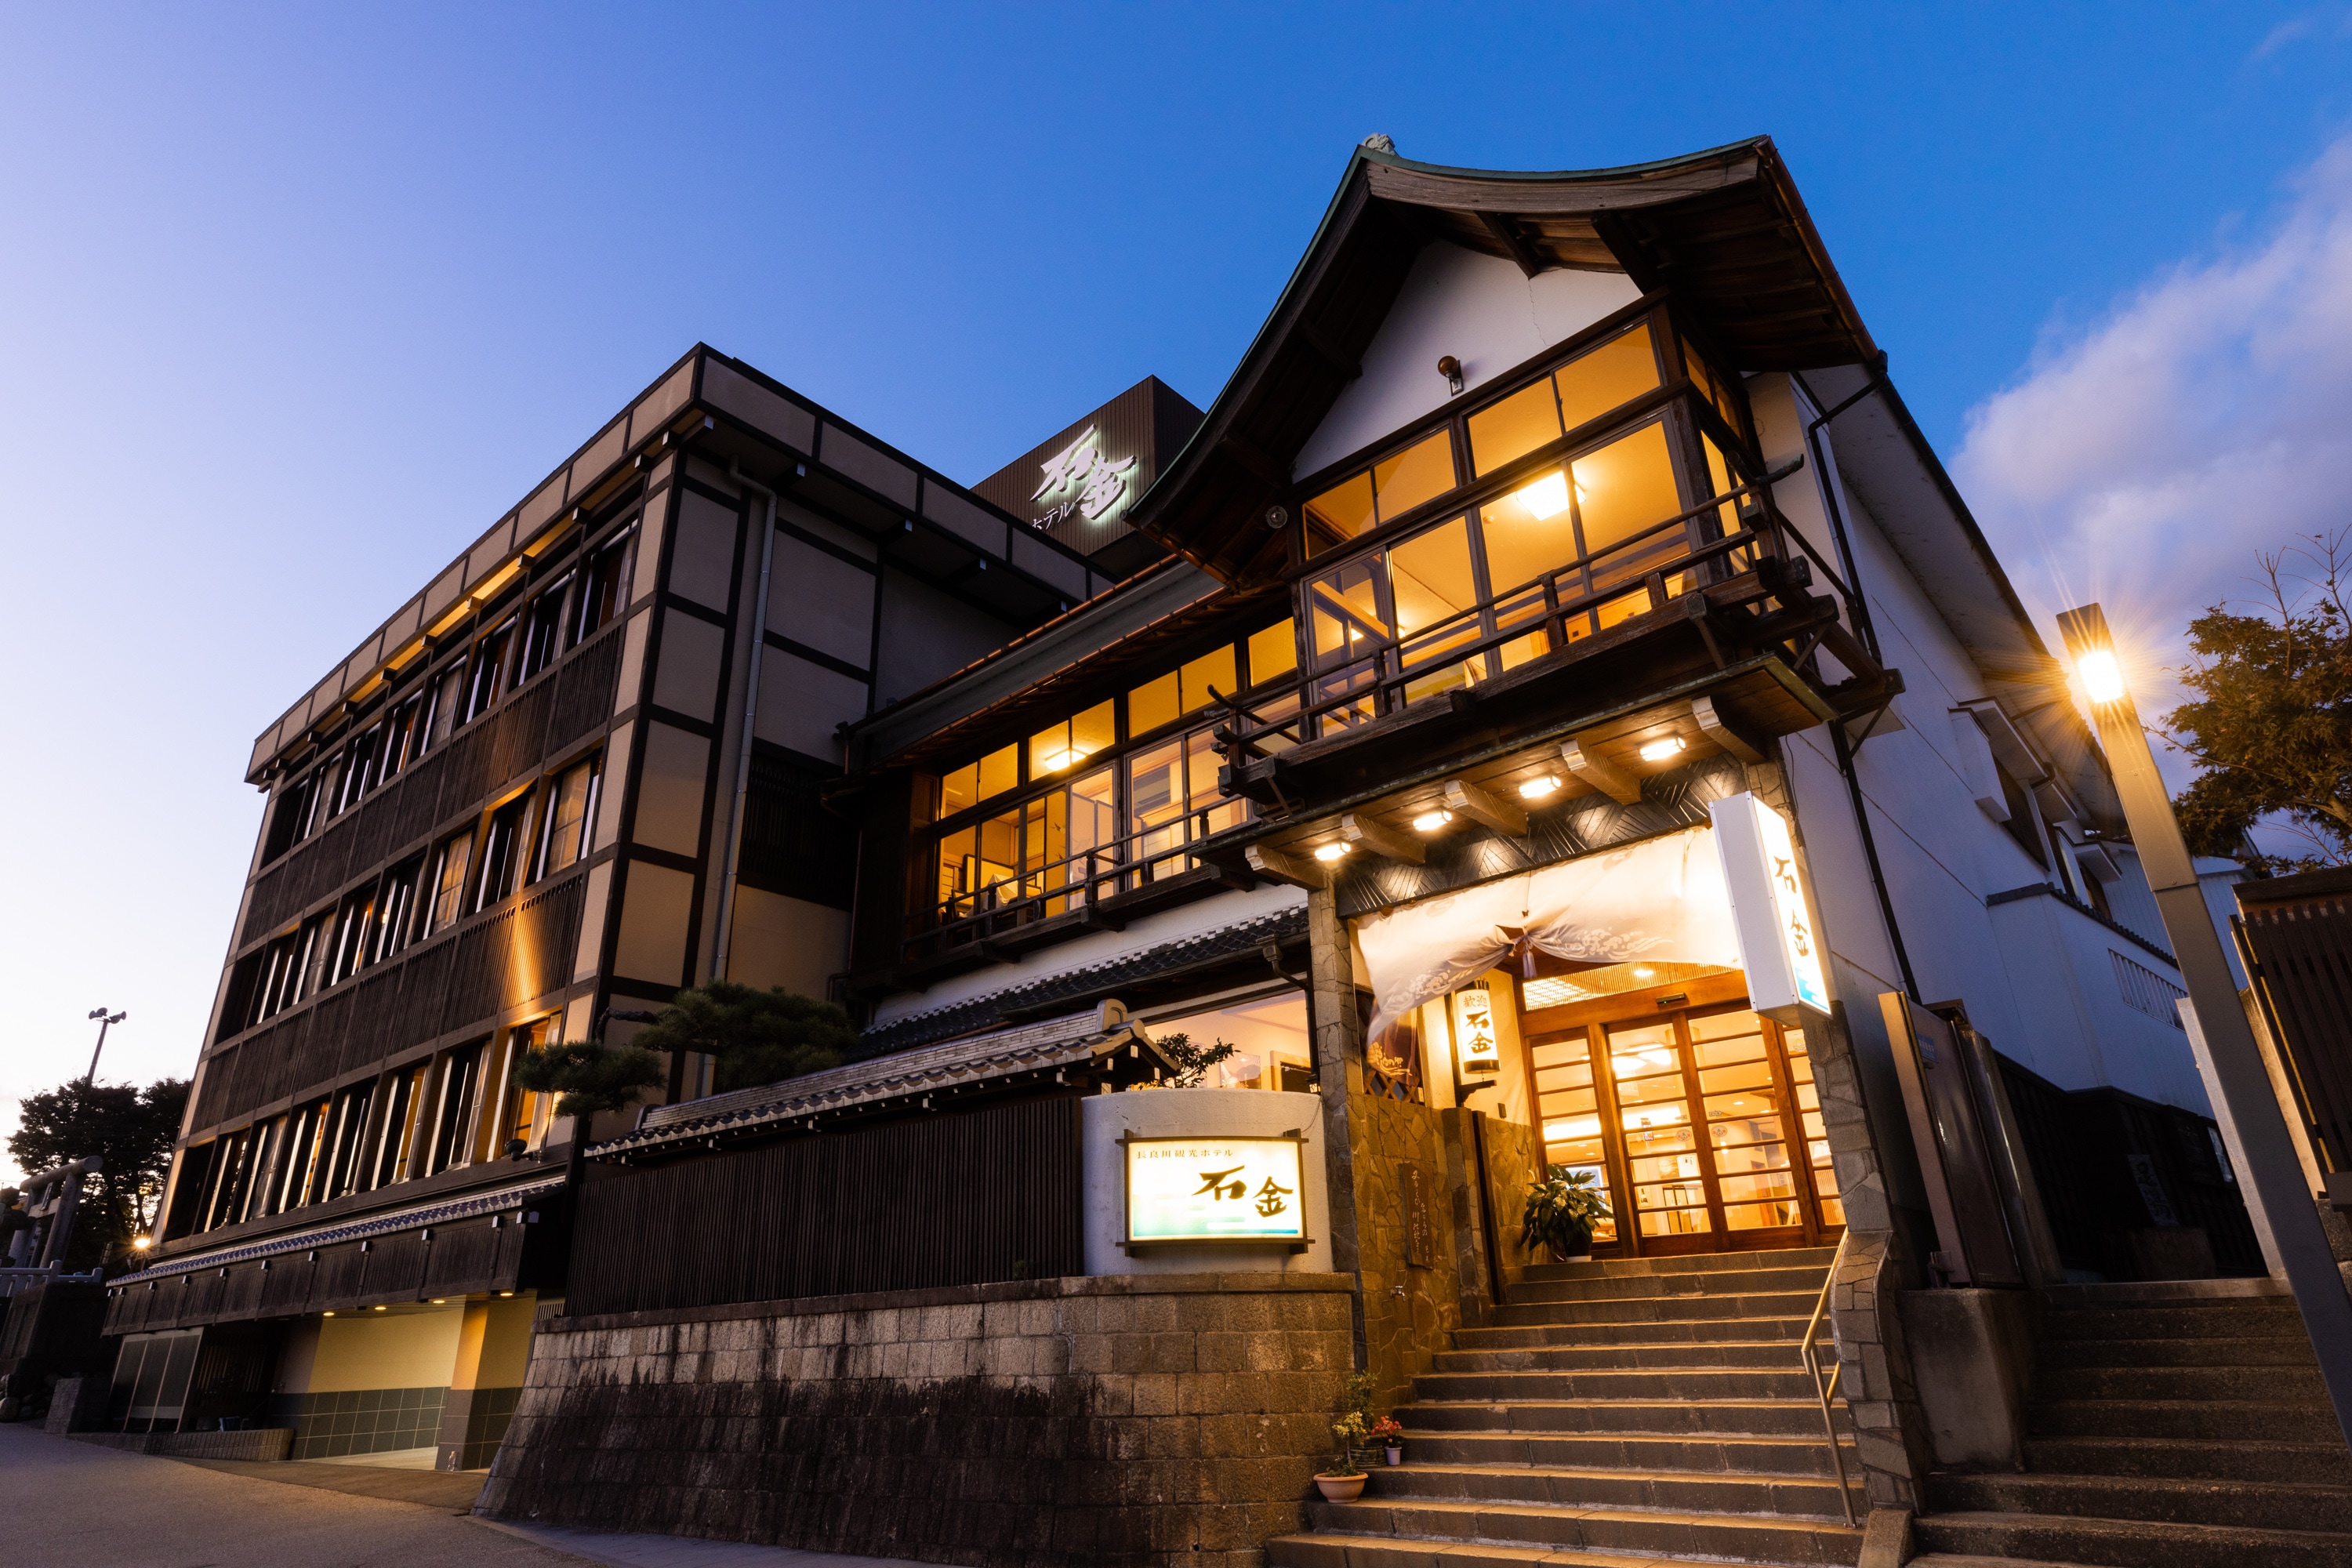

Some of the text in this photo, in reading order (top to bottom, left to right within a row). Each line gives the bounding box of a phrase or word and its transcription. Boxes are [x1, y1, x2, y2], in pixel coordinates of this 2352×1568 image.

[1029, 423, 1137, 520] 石金
[1033, 502, 1076, 530] ホテル
[1774, 855, 1809, 956] 石金
[1465, 1011, 1494, 1054] 石金
[1137, 1149, 1233, 1159] 長良川観光ホテル
[1191, 1165, 1294, 1218] 石金
